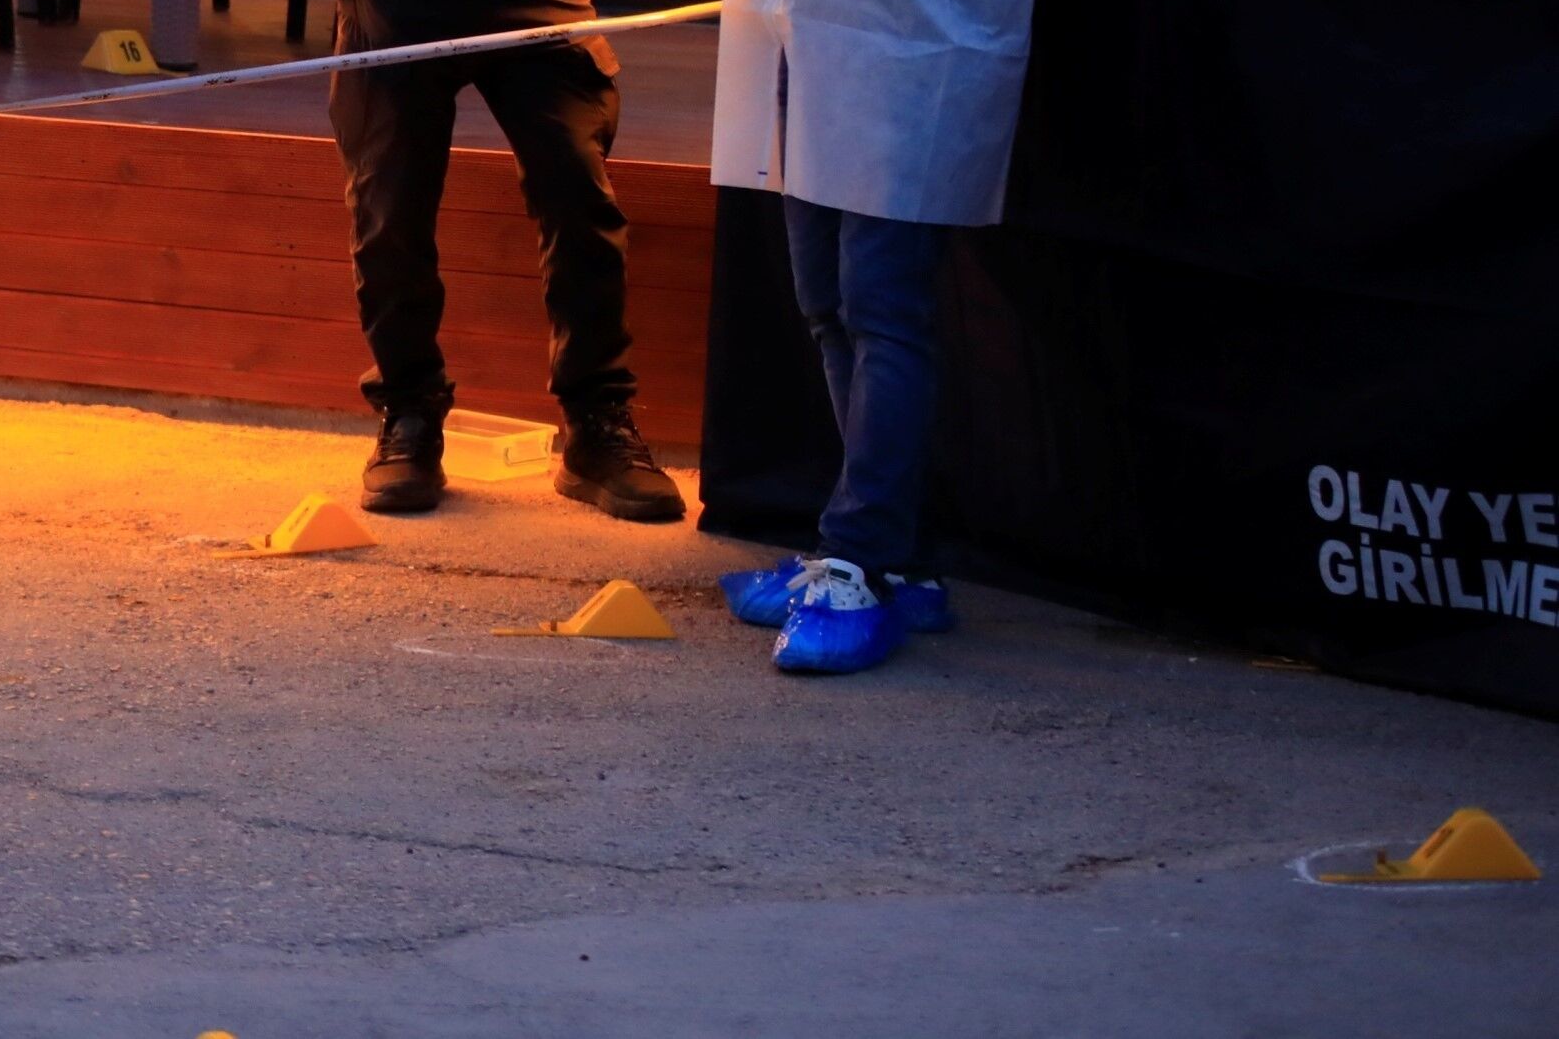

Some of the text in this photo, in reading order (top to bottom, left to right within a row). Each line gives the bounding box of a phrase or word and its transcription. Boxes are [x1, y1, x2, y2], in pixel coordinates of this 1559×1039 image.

[119, 40, 142, 62] 16
[1308, 464, 1559, 548] OLAY YE
[1318, 532, 1558, 628] GİRİLME
